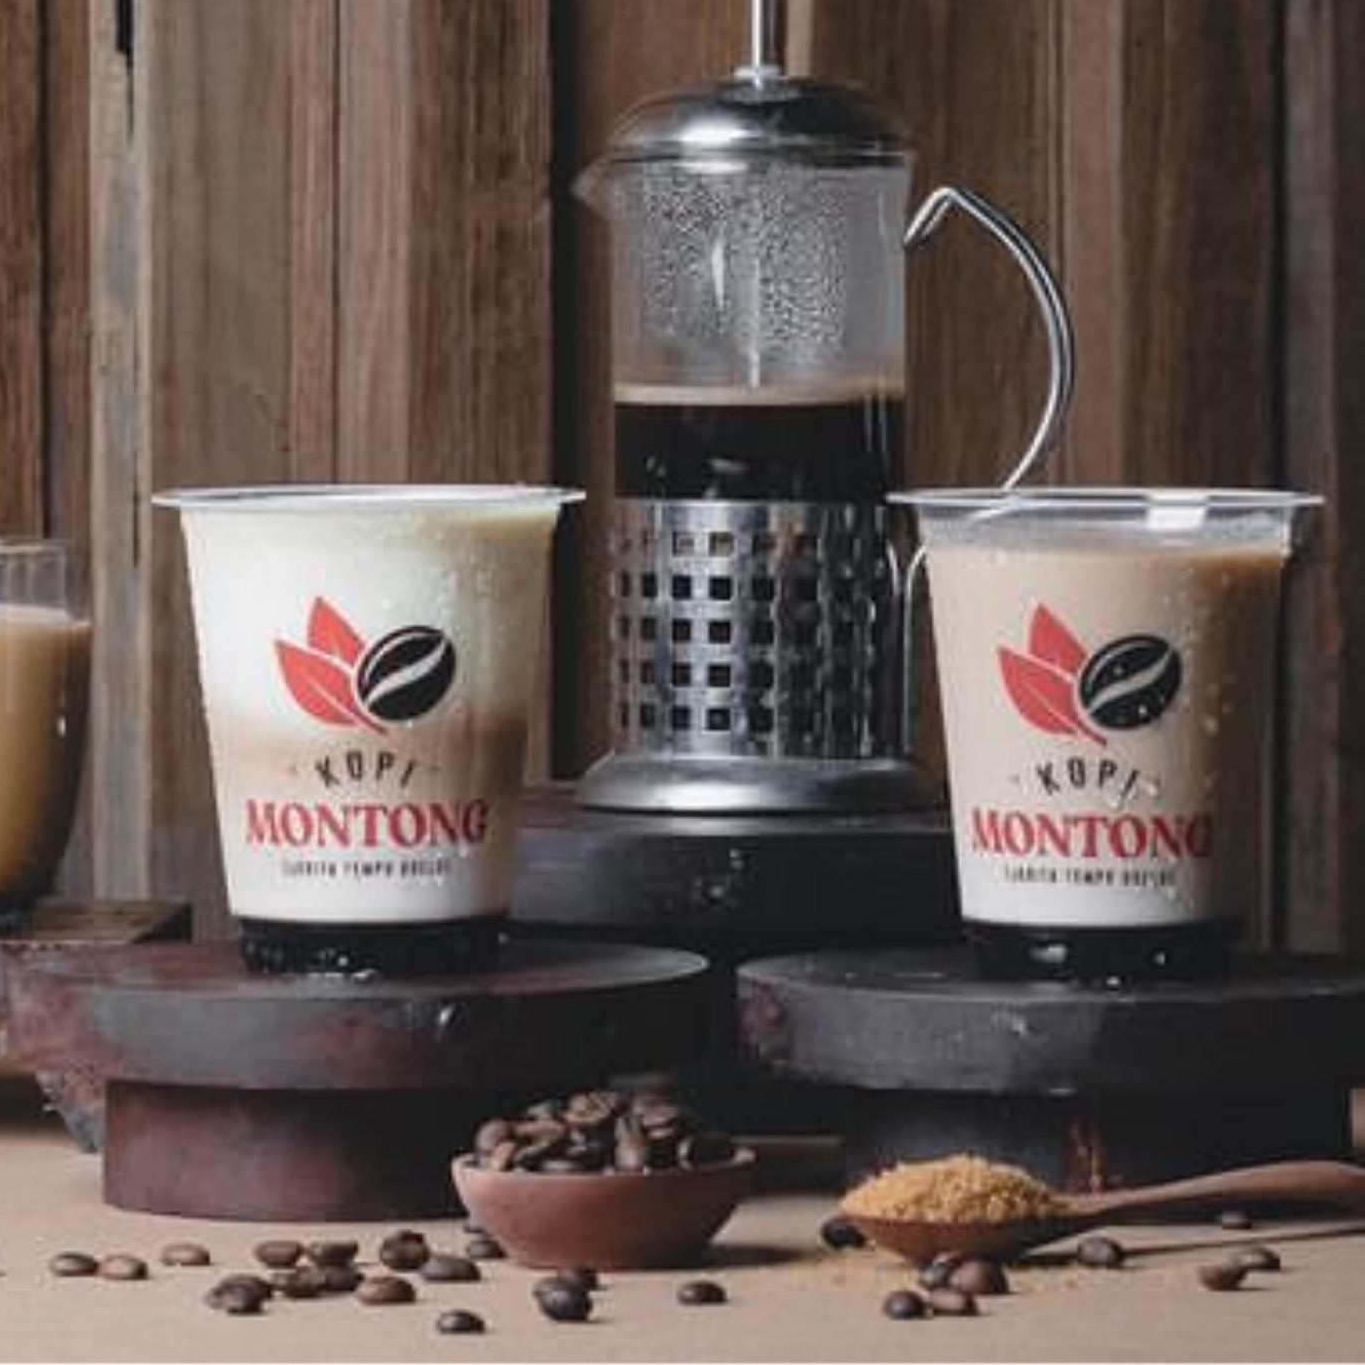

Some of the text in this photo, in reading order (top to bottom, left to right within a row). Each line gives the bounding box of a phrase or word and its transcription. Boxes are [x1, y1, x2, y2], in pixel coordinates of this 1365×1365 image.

[315, 750, 417, 789] KOPI
[1037, 757, 1140, 799] KOPI
[245, 798, 490, 849] MONTONG
